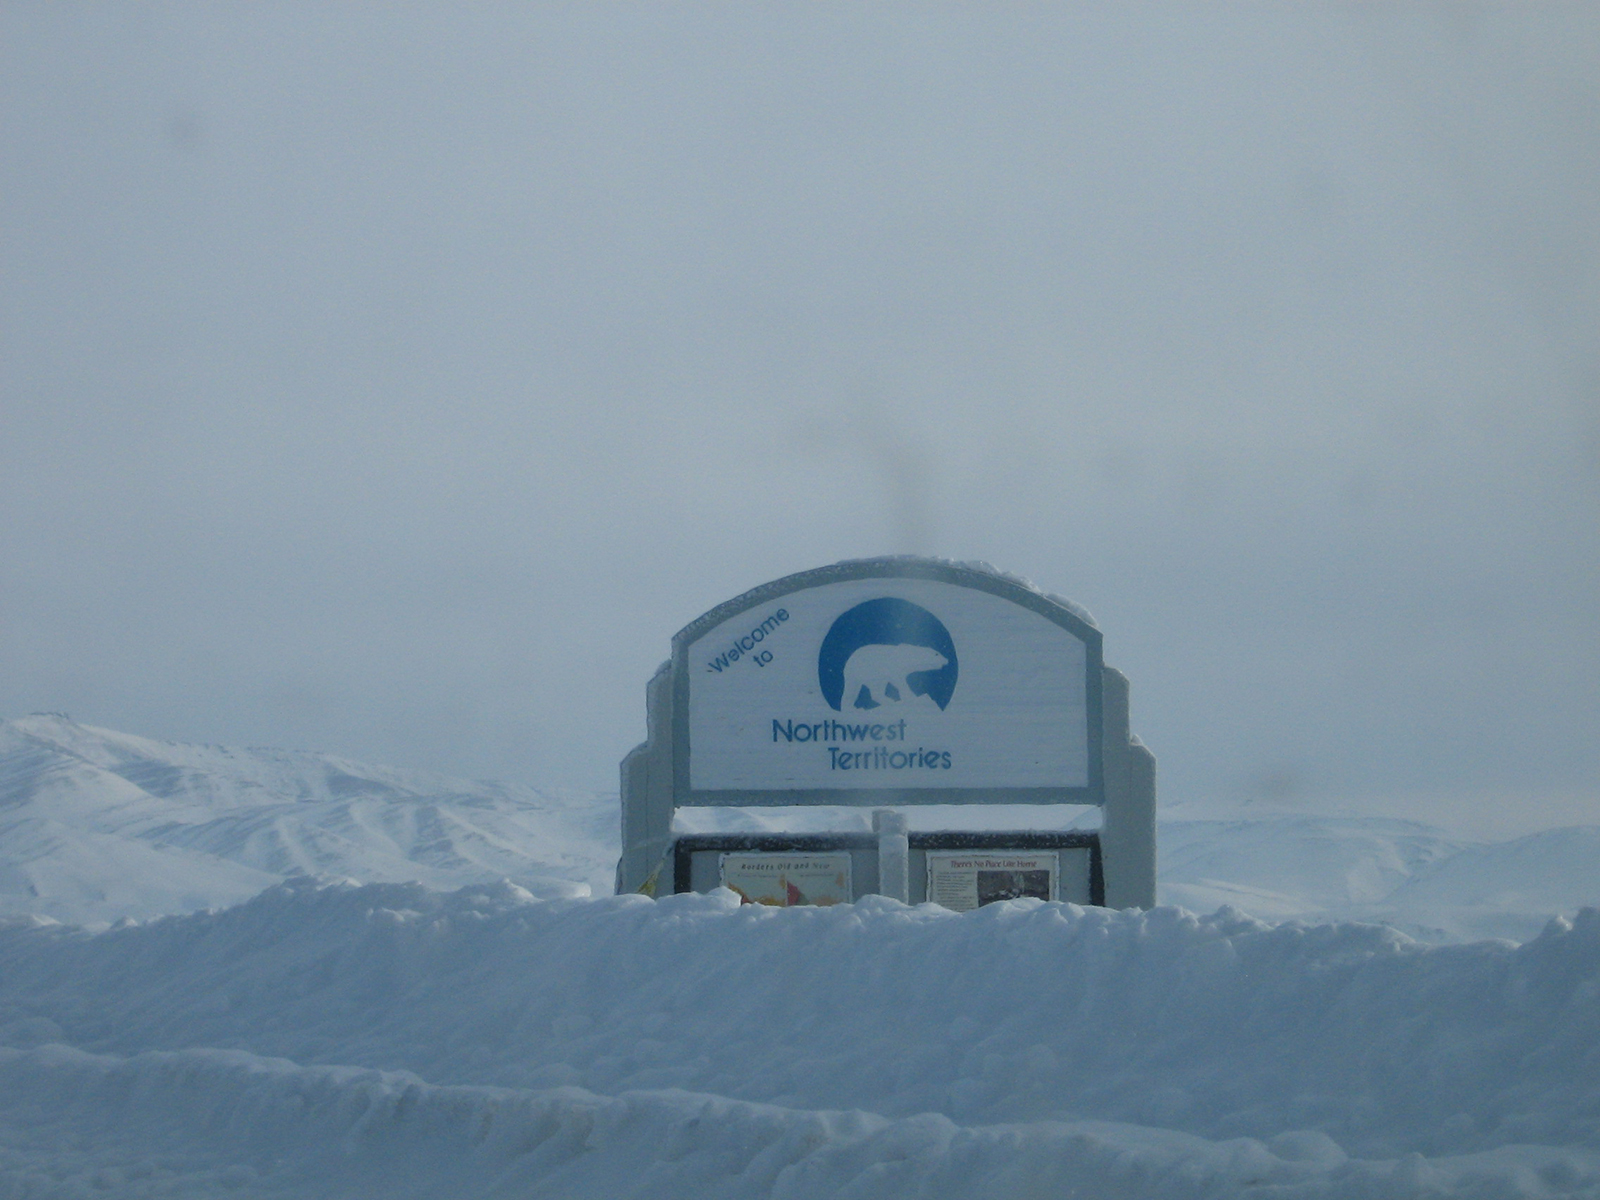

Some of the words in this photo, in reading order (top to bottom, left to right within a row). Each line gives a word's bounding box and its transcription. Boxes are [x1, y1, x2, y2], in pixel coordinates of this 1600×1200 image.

[708, 608, 790, 673] Welcome
[753, 650, 774, 668] to
[772, 719, 907, 742] Northwest
[828, 746, 952, 770] Territories
[974, 860, 985, 868] No
[1017, 860, 1038, 868] Home
